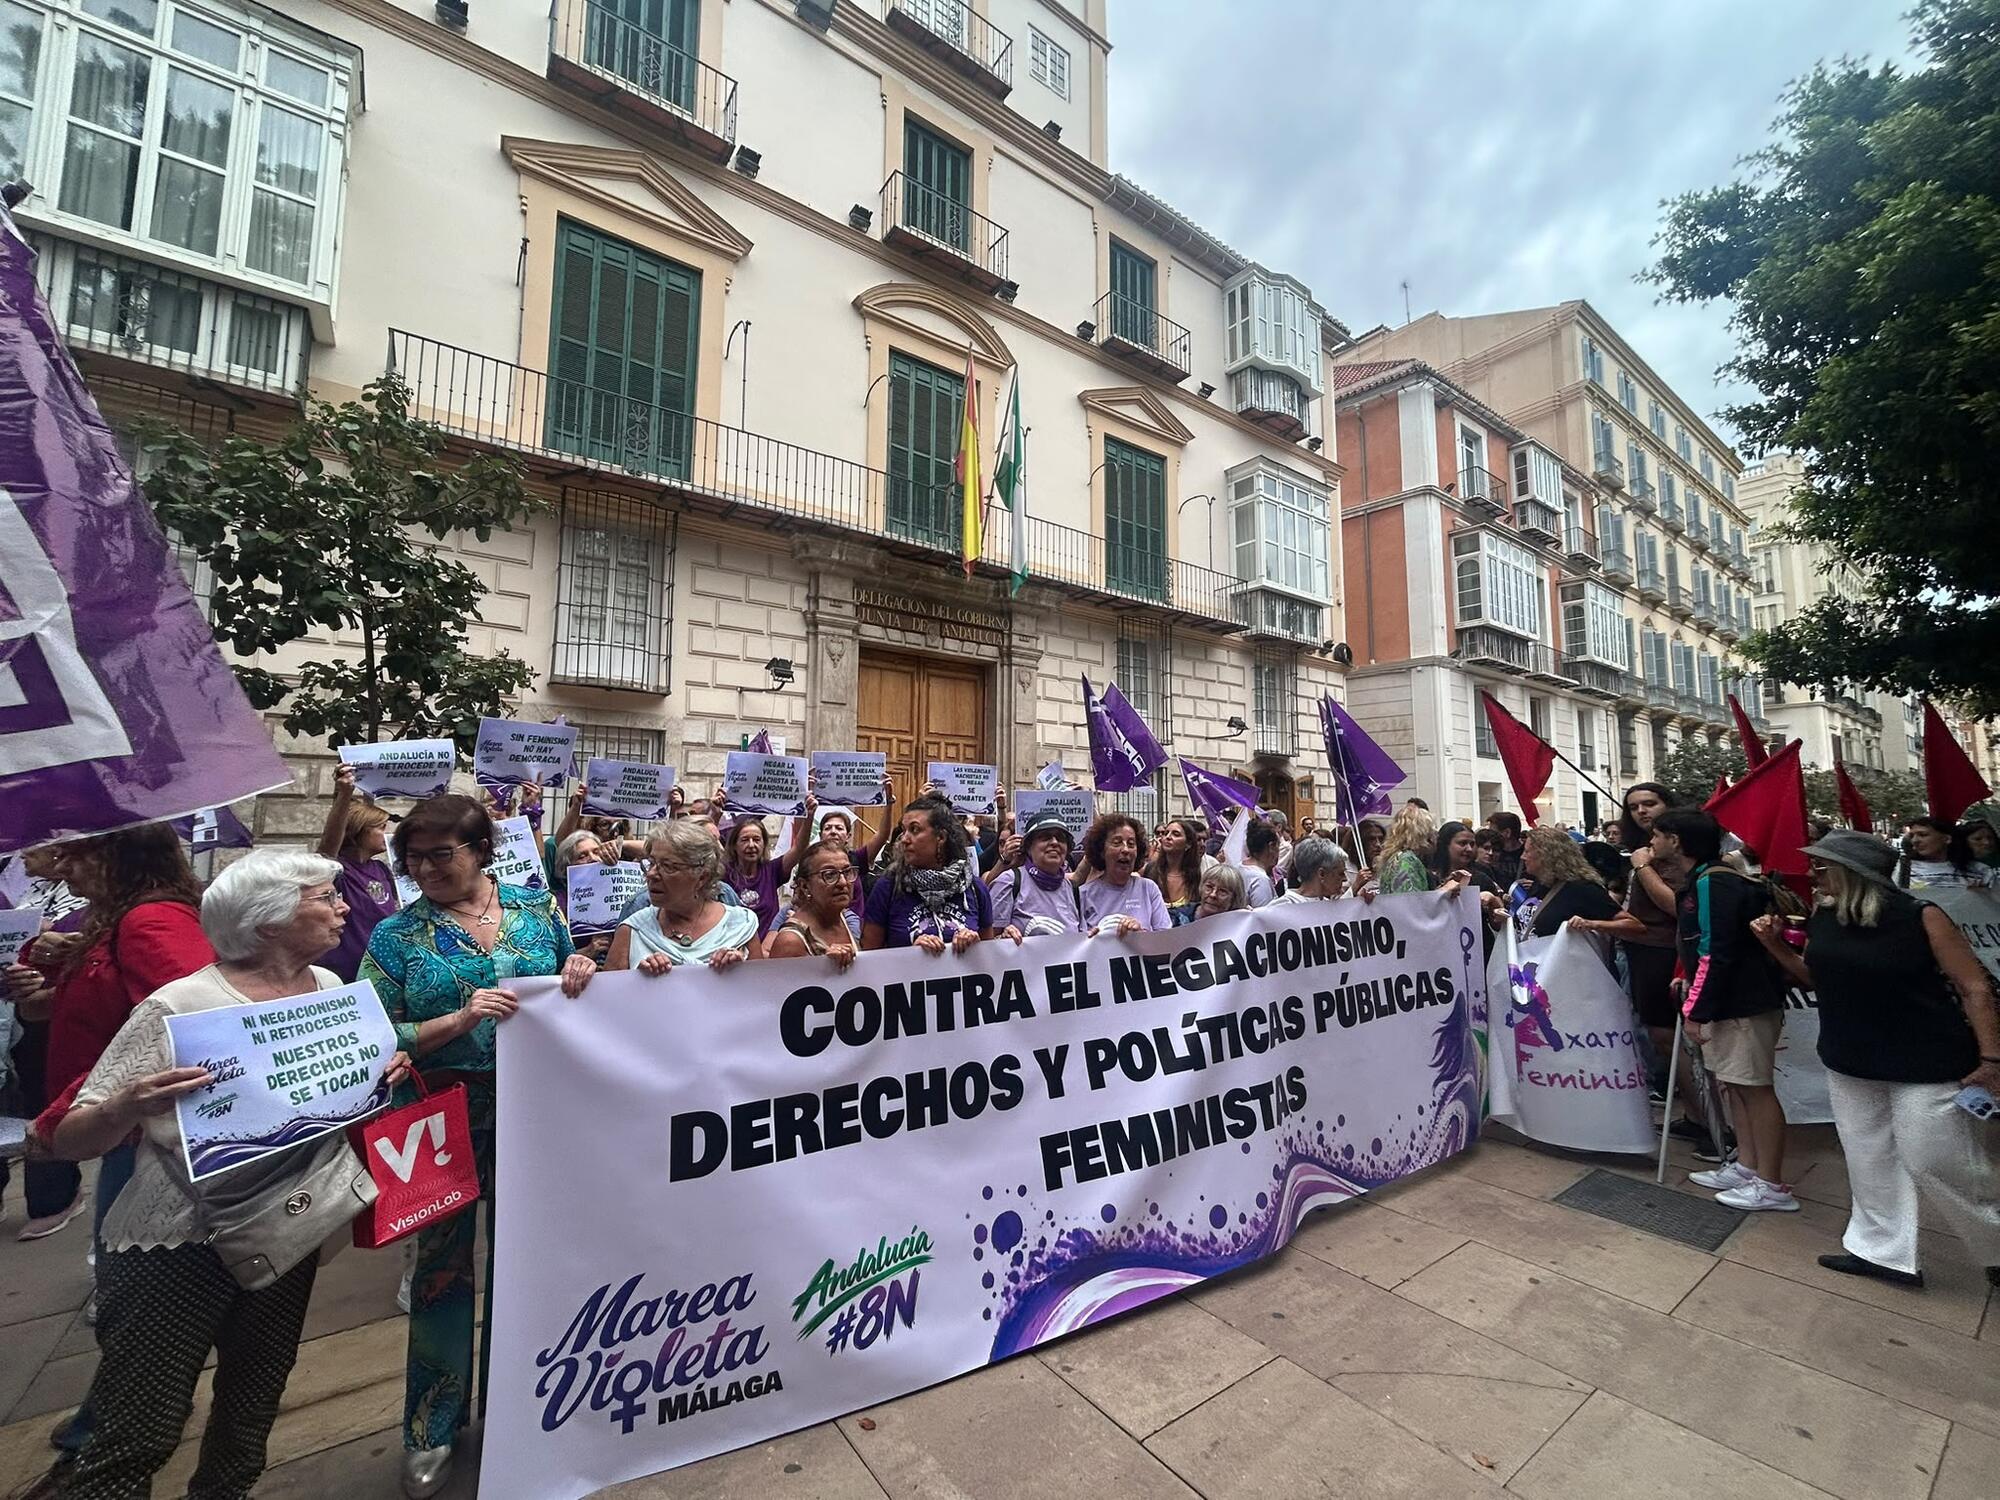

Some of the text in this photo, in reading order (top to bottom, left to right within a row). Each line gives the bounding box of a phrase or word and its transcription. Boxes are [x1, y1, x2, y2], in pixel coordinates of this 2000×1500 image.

[861, 607, 901, 628] JUNTA
[912, 617, 929, 632] DE
[932, 603, 951, 619] DEL
[957, 608, 1010, 631] GOBIERNO
[510, 733, 570, 746] SIN FEMINISMO
[379, 749, 450, 760] ANDALUCÍA NO
[523, 744, 554, 754] NO HAY
[509, 754, 561, 765] DEMOCRACIA
[763, 760, 785, 768] NEGAR
[377, 761, 451, 770] RETROCEDE EN
[386, 770, 438, 778] DERECHOS
[622, 766, 660, 777] ANDALUCÍA
[762, 768, 795, 777] VIOLENCIA
[622, 774, 657, 784] FEMINISTA
[756, 776, 789, 784] MACHISTA
[620, 782, 647, 790] FRENTE
[753, 784, 793, 793] ABANDONAR
[612, 788, 661, 798] NEGACIONISMO
[953, 794, 987, 802] COMBATEN
[610, 796, 659, 805] INSTITUCIONAL
[1045, 797, 1081, 806] ANDALUCÍA
[1061, 807, 1086, 815] CONTRA
[600, 868, 623, 876] QUIEN
[612, 885, 624, 893] NO
[779, 915, 1407, 1058] CONTRA EL NEGACIONISMO,
[242, 995, 357, 1029] NI NEGACIONISMO
[252, 1010, 361, 1045] NI RETROCESOS:
[272, 1031, 360, 1067] NUESTROS
[266, 1044, 380, 1090] DERECHOS NO
[669, 966, 1455, 1184] DERECHOS Y POLÍTICAS PÚBLICAS
[289, 1066, 370, 1106] SE TOCAN
[207, 1101, 233, 1119] #8N
[1039, 1064, 1308, 1192] FEMINISTAS
[389, 1190, 462, 1233] VisionLab
[791, 1224, 935, 1330] Andalucía
[824, 1266, 921, 1359] #8N
[535, 1272, 758, 1368] Marea
[535, 1318, 770, 1434] Violeta
[658, 1370, 784, 1426] MÁLAGA
